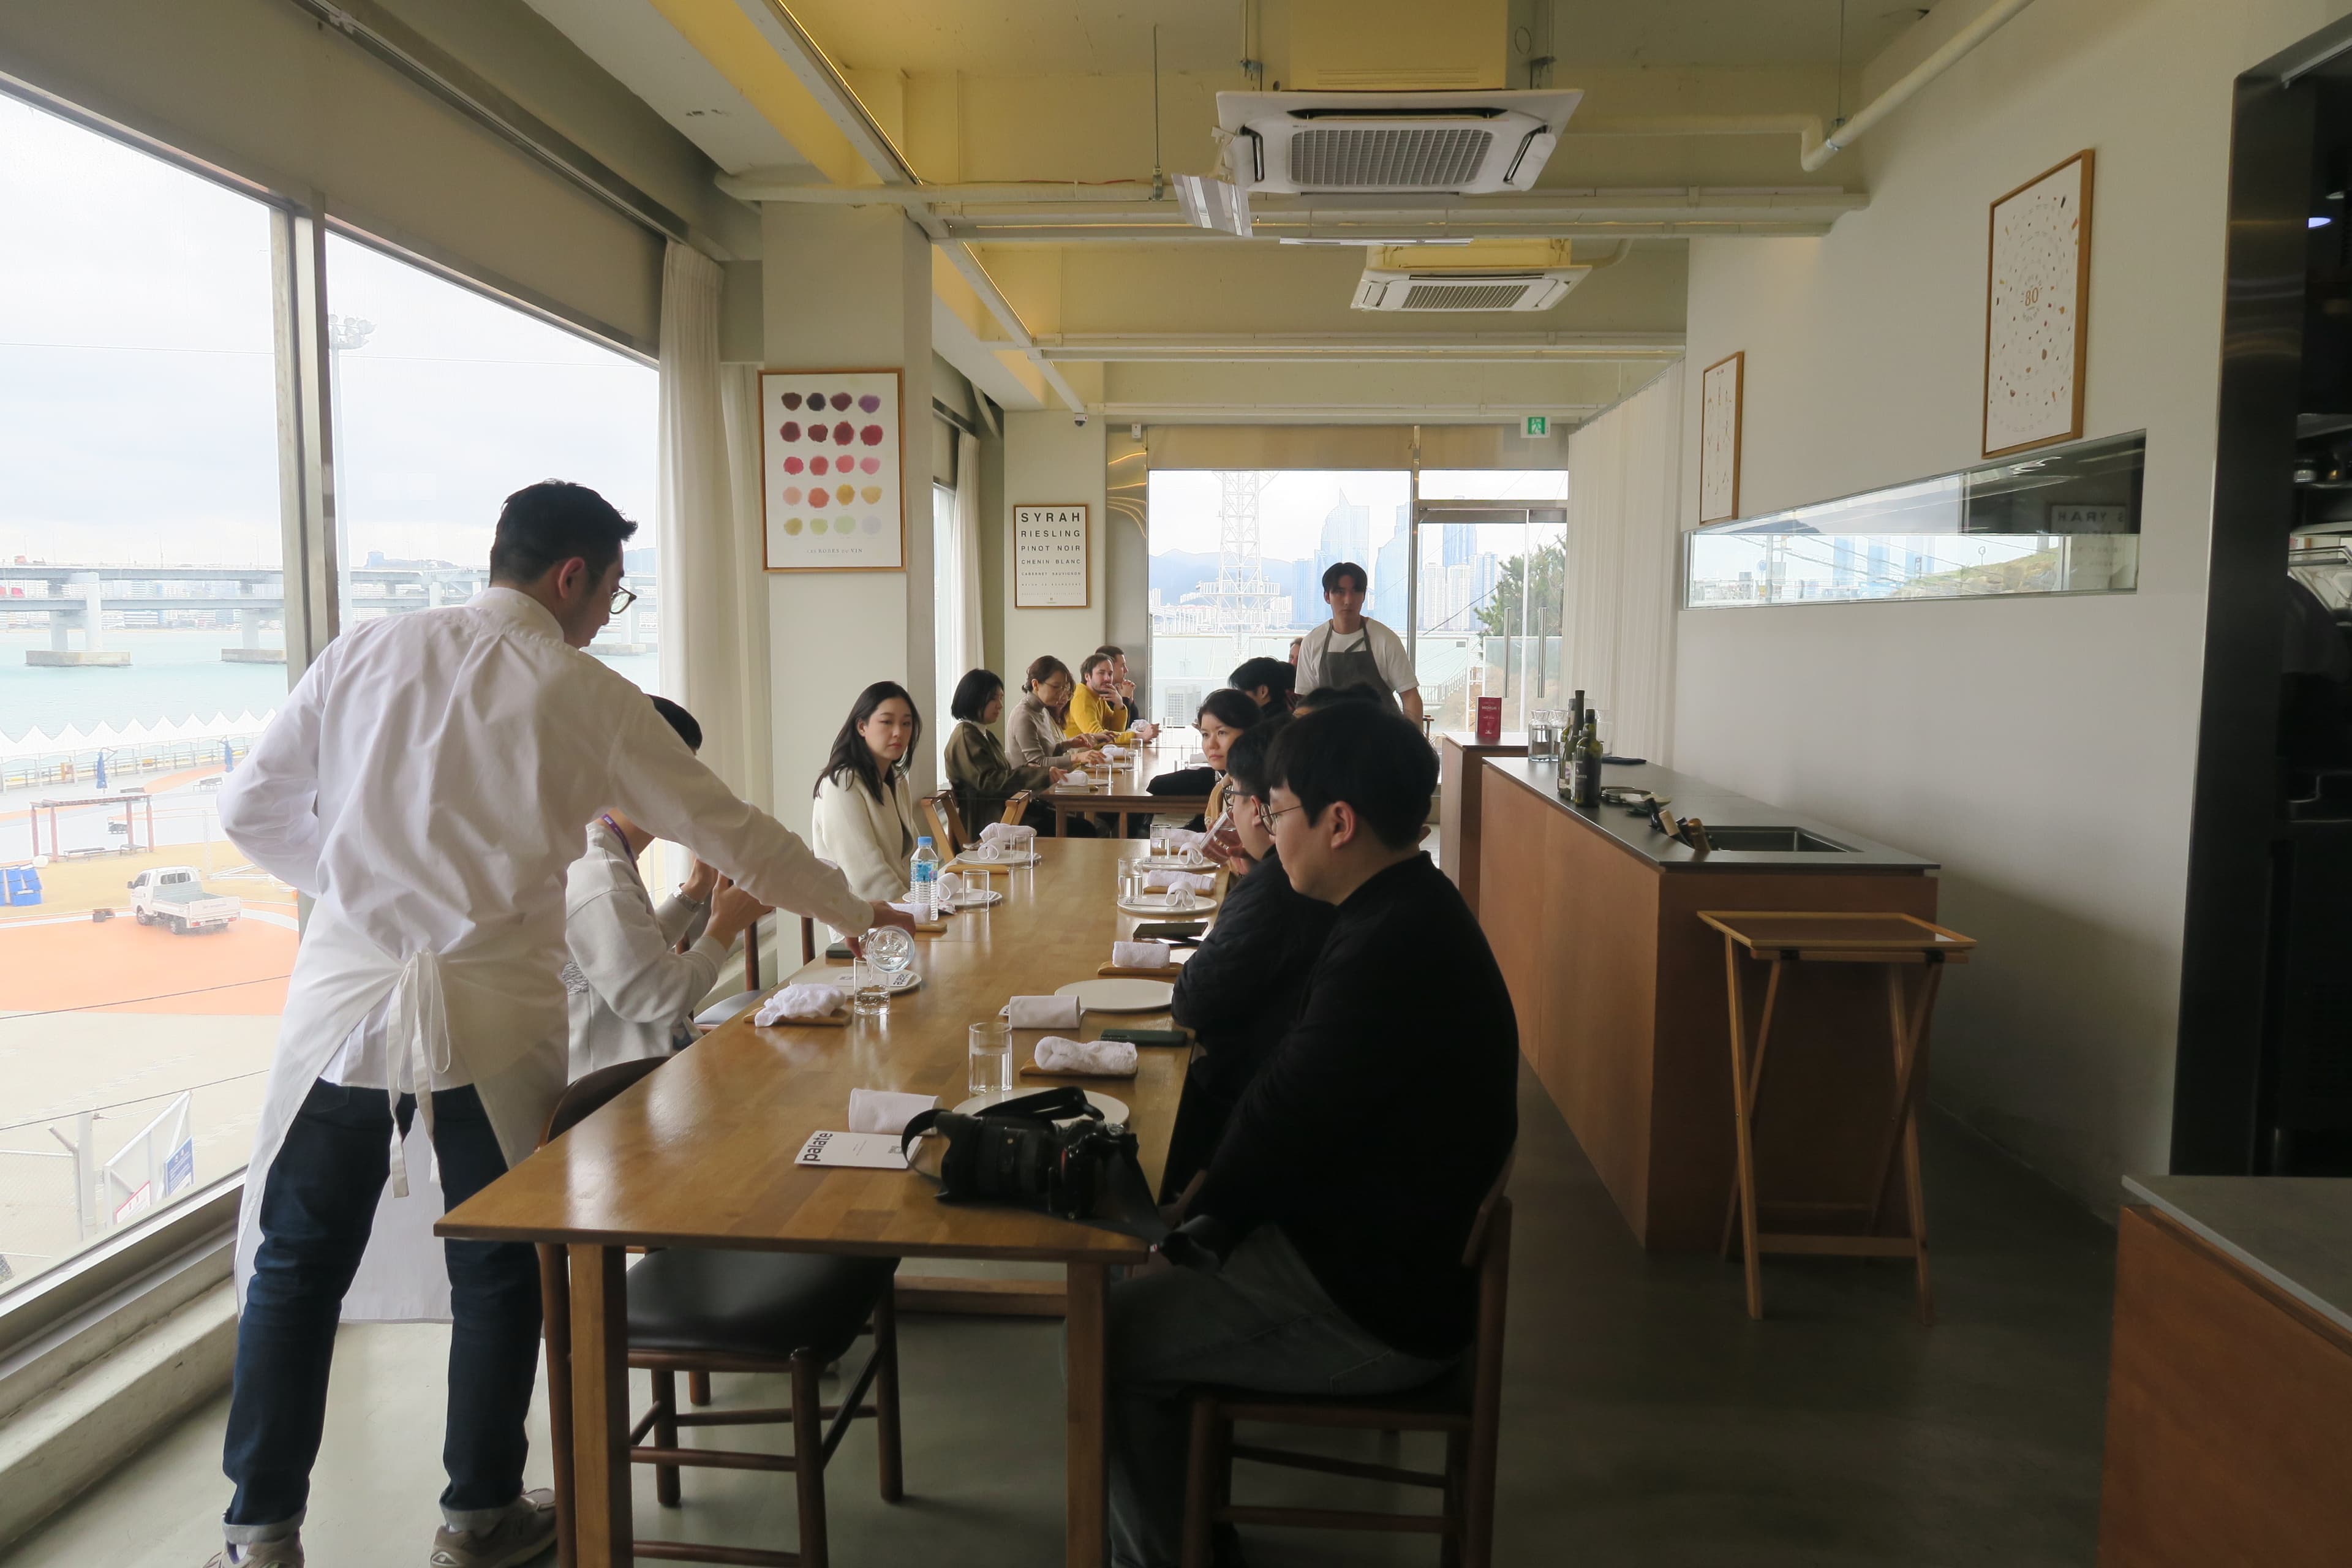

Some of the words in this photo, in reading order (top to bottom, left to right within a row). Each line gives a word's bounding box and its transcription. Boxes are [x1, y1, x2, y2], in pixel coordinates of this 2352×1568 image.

[2025, 287, 2038, 306] 80
[1021, 513, 1080, 522] SYRAH
[802, 1133, 833, 1161] palate
